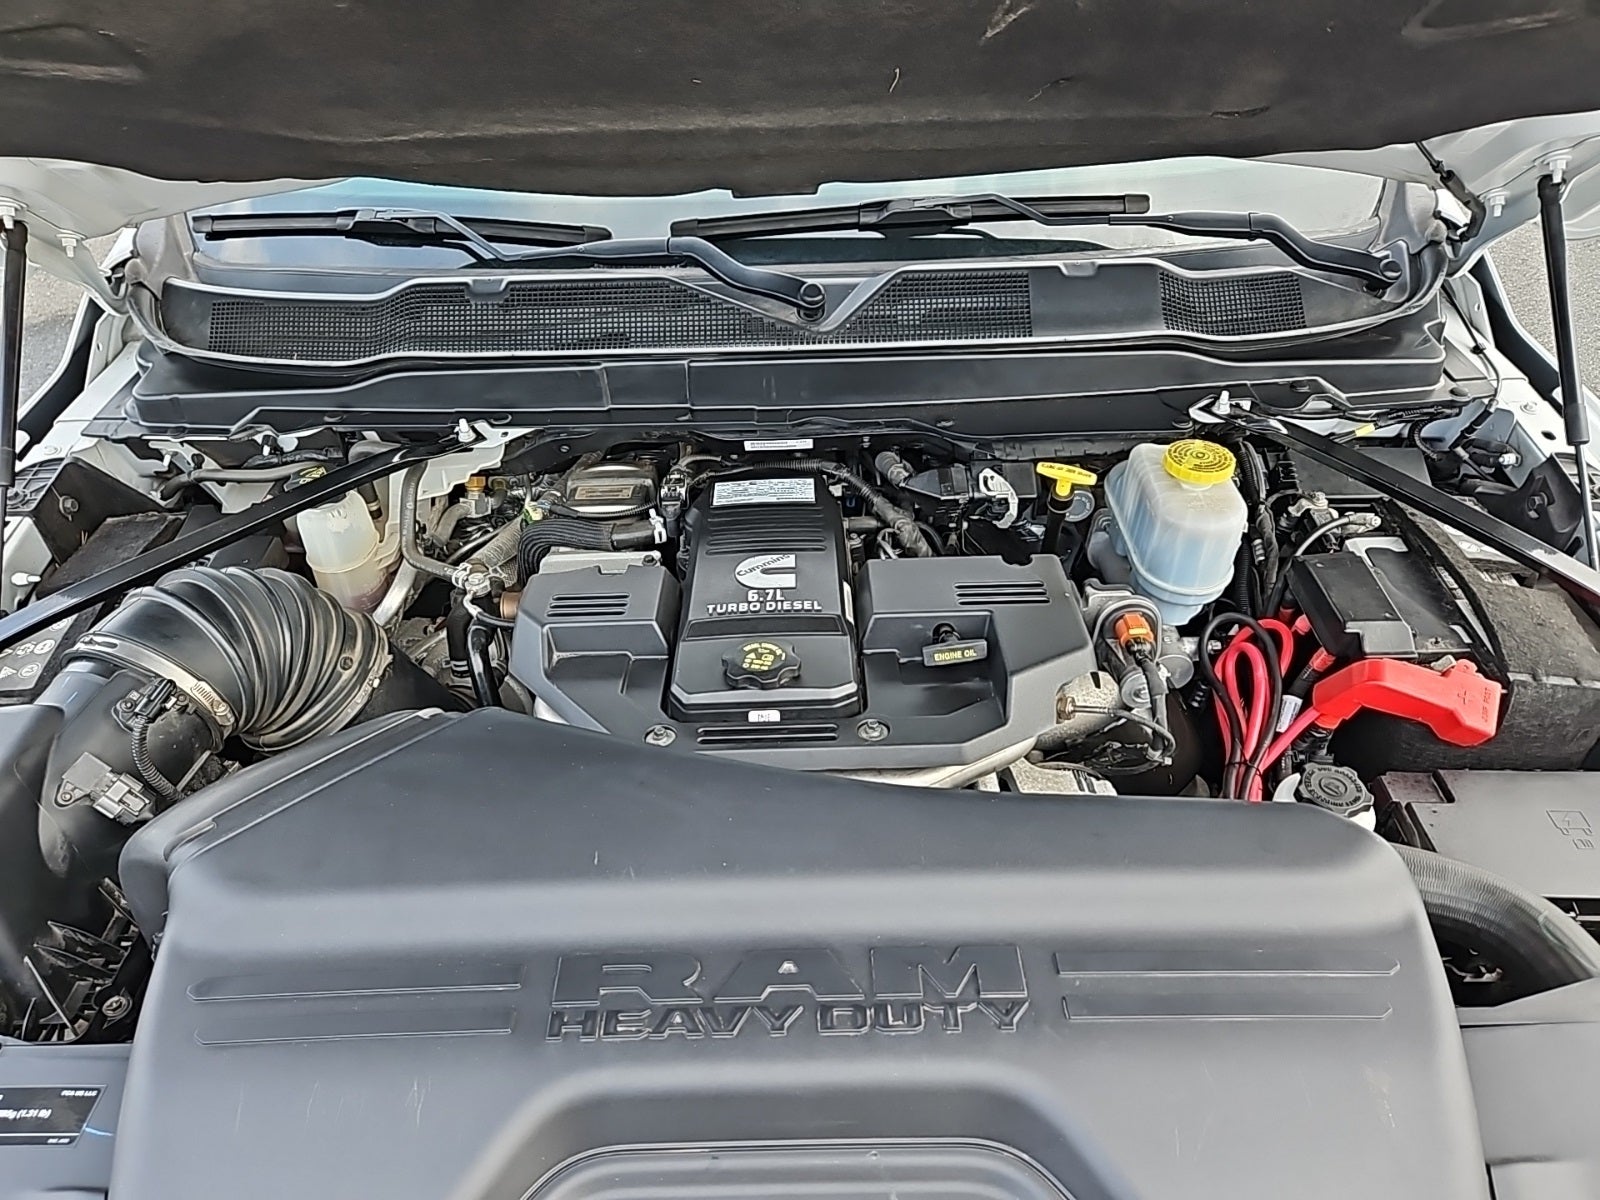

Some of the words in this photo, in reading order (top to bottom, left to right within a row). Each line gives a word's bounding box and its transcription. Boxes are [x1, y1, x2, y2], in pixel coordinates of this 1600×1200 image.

[736, 552, 791, 577] Cummins
[747, 588, 786, 602] 6.7L
[706, 602, 761, 616] TURBO
[765, 599, 823, 612] DIESEL
[933, 650, 963, 662] ENGINE
[963, 648, 978, 658] OIL
[552, 946, 1028, 1006] RAM
[545, 1004, 804, 1042] HEAVY
[815, 999, 1031, 1036] DUTY
